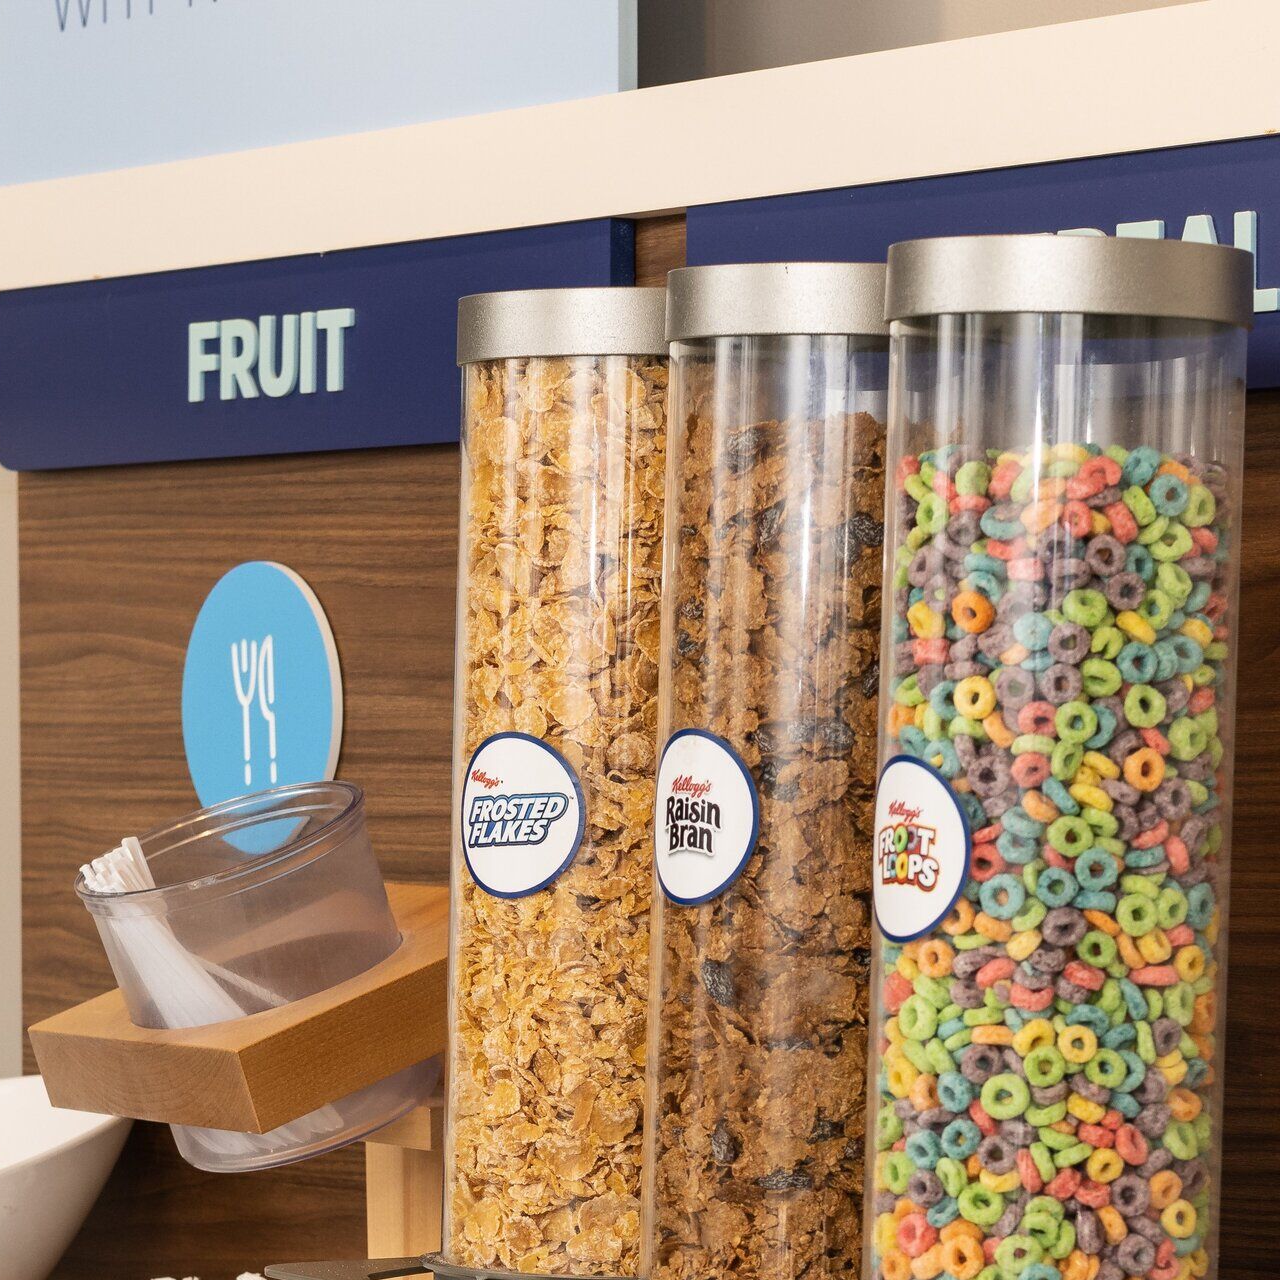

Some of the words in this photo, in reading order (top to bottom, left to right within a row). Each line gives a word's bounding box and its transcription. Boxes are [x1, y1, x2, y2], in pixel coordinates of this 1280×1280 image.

[188, 308, 355, 402] FRUIT
[471, 769, 500, 789] Kellogg's
[672, 774, 712, 798] Kellogg's
[469, 794, 568, 823] FROSTED
[666, 795, 721, 829] Raisin
[469, 820, 548, 846] FLAKES
[669, 823, 713, 853] Bran
[879, 825, 936, 861] FROOT
[882, 852, 939, 891] LOOPS
